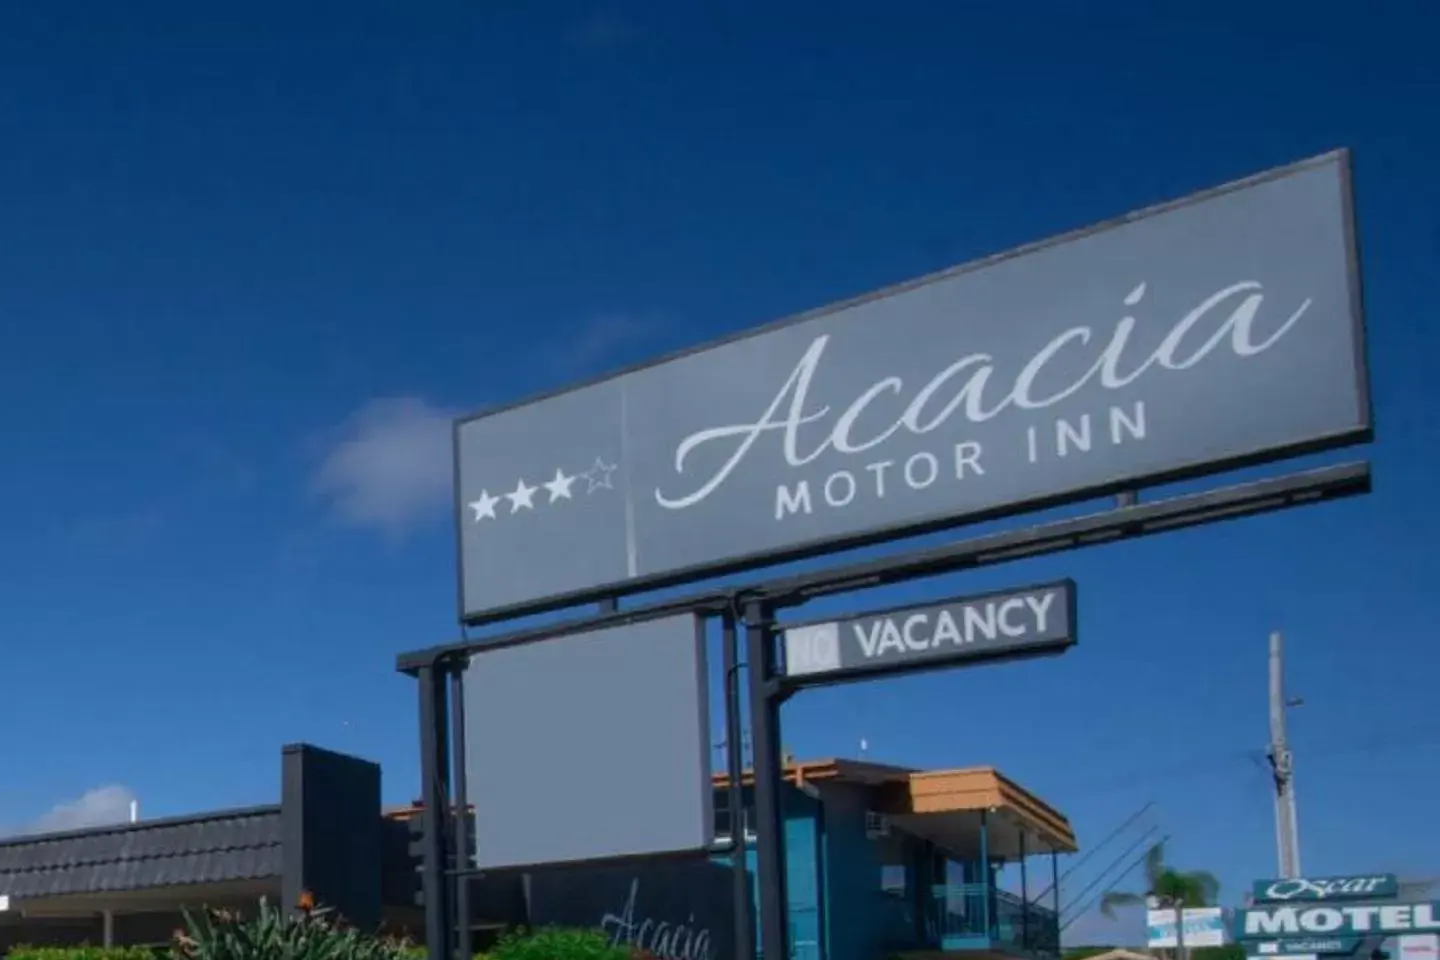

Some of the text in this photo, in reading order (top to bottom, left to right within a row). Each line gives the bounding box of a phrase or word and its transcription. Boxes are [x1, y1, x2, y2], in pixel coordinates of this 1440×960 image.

[655, 281, 1312, 509] Acacia
[774, 401, 1148, 520] MOTOR INN
[853, 593, 1057, 657] VACANCY
[1245, 905, 1440, 934] MOTEL
[1266, 876, 1387, 899] Oscar
